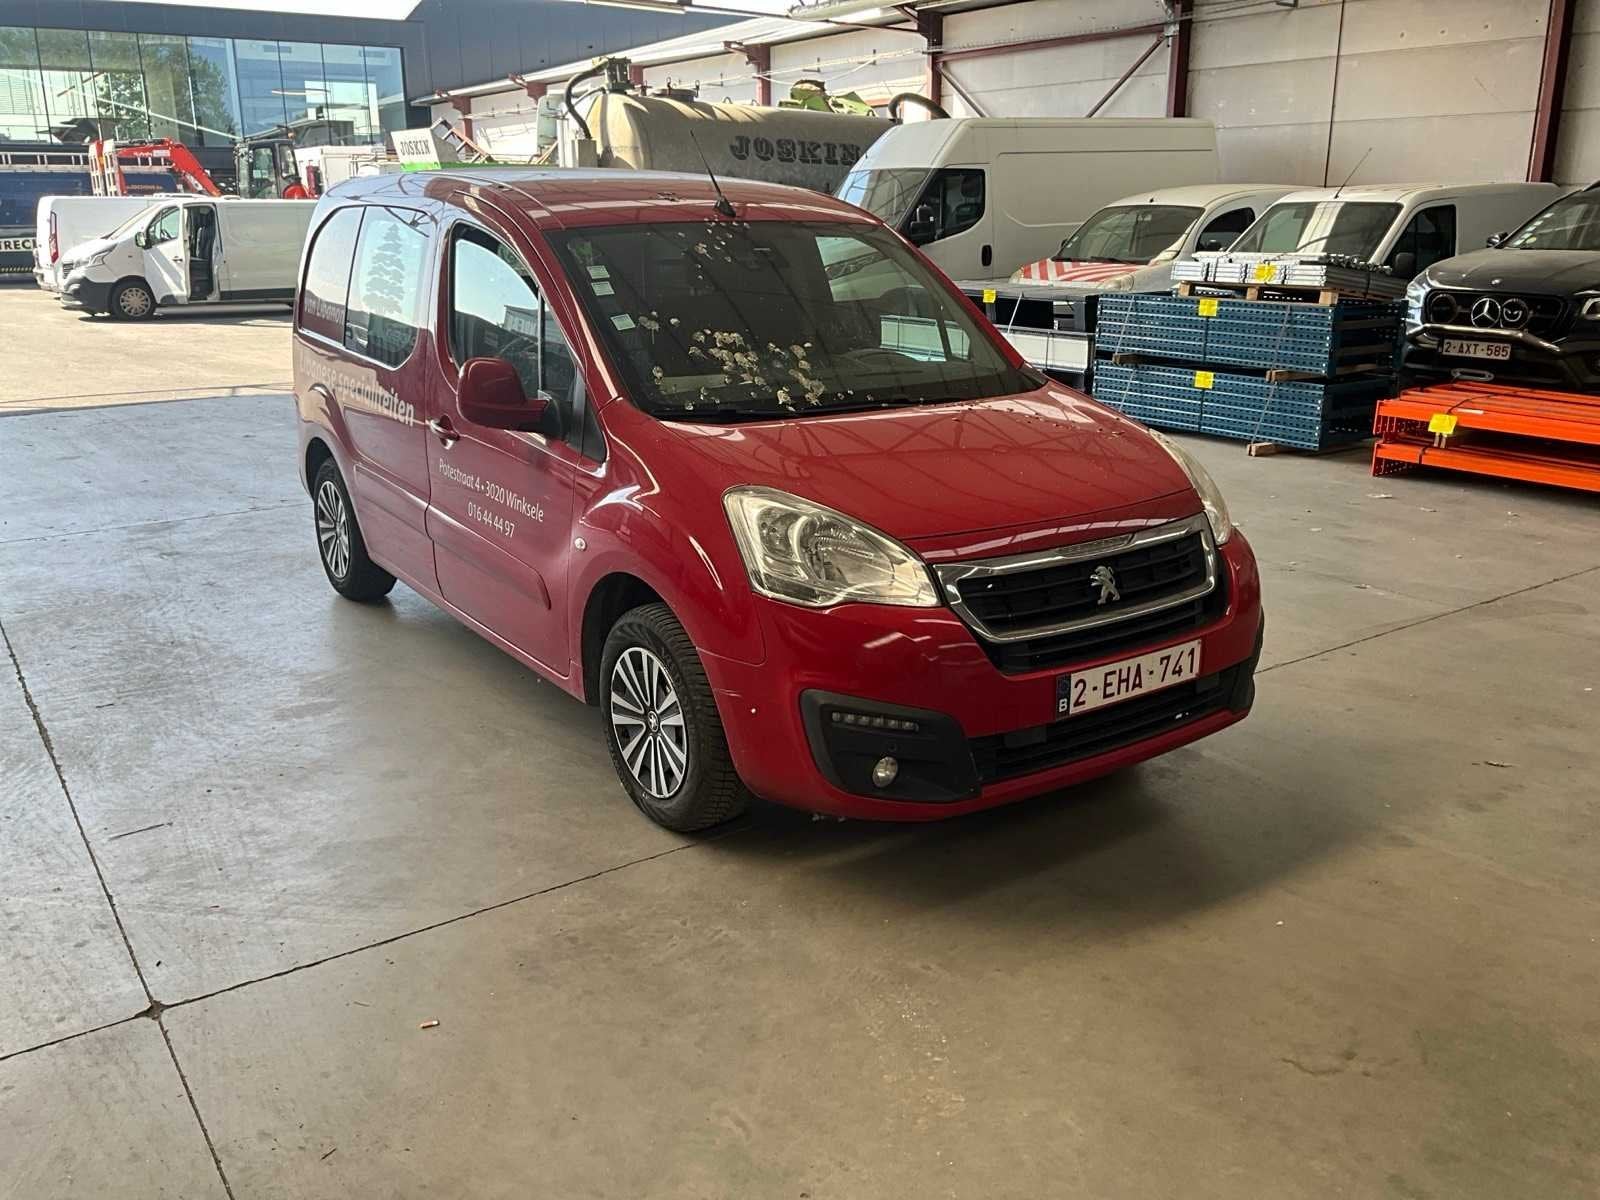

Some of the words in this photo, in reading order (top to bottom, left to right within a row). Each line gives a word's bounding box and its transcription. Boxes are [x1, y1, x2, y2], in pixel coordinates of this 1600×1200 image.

[400, 140, 431, 156] JOSKIN
[730, 135, 862, 166] JOSKIN
[474, 477, 480, 491] 4
[485, 481, 505, 504] 3020
[506, 491, 544, 522] Winksele
[467, 501, 482, 521] 016
[482, 509, 493, 527] 44
[493, 514, 503, 533] 44
[504, 520, 515, 537] 97
[1058, 698, 1068, 712] B
